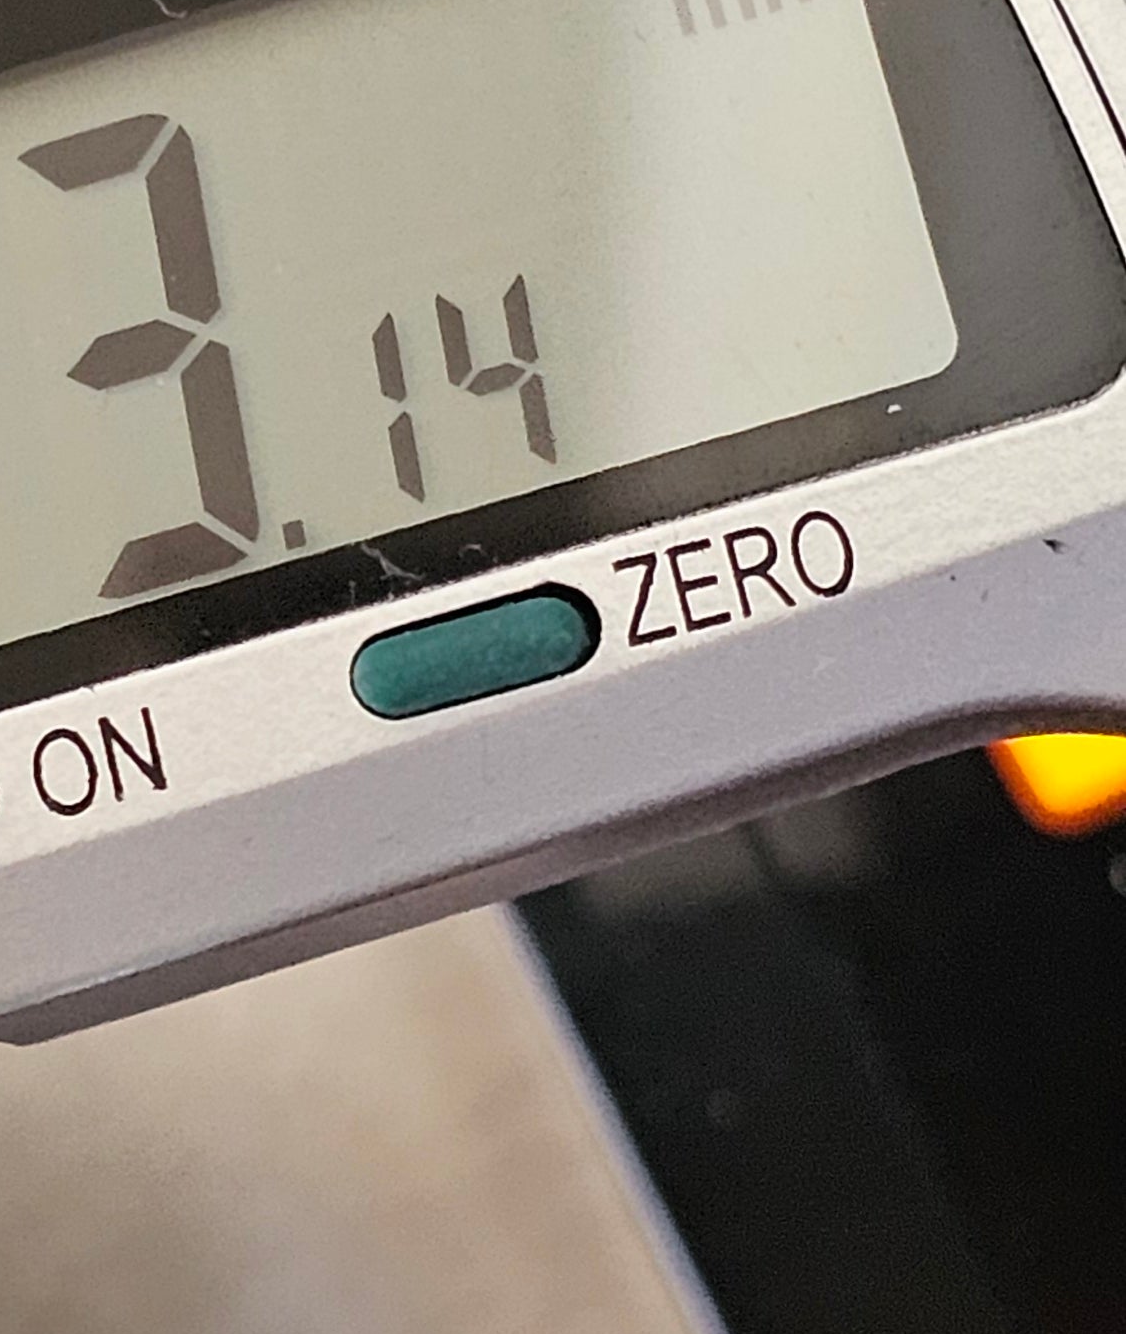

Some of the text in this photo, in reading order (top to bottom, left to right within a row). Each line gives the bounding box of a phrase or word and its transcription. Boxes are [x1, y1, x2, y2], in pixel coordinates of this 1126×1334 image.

[17, 113, 557, 599] 3.14
[613, 510, 854, 648] ZERO
[31, 707, 166, 817] ON
